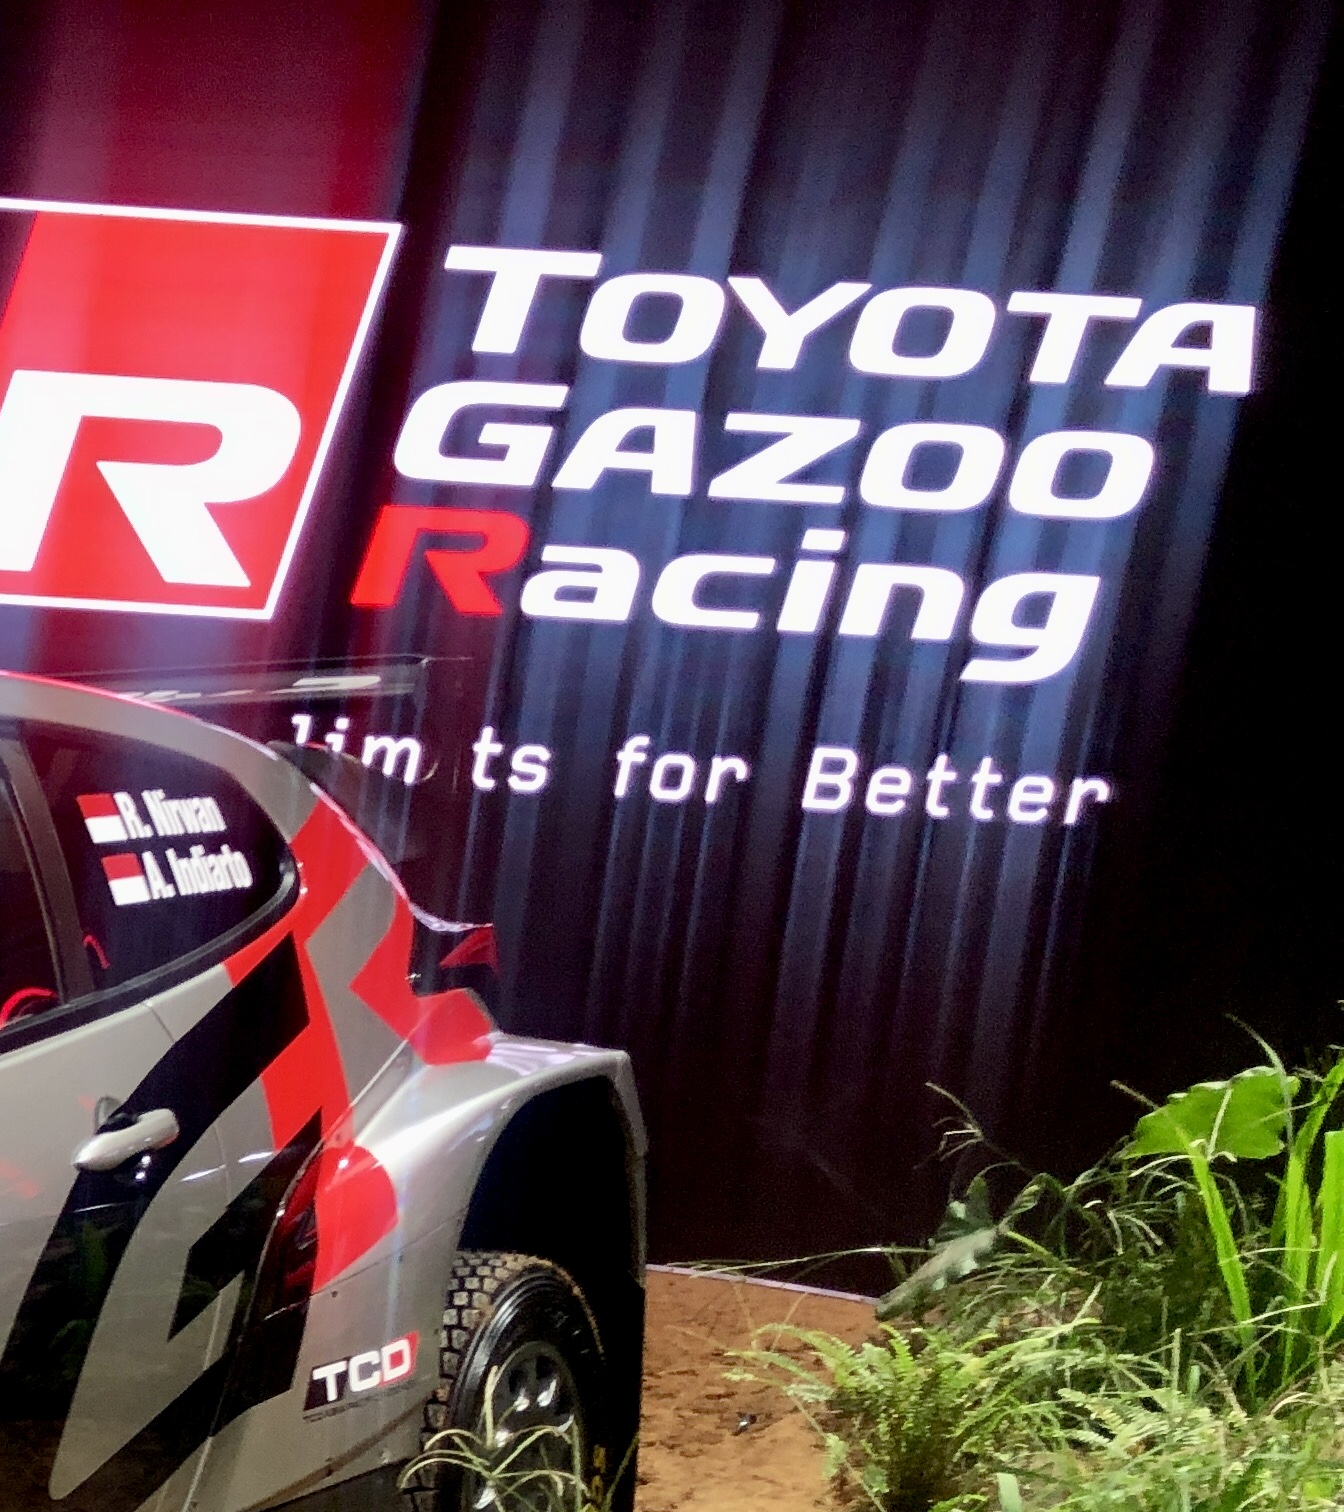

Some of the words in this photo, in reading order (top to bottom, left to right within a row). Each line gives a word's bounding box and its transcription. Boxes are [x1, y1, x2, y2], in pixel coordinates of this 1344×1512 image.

[443, 245, 1258, 394] TOYOTA
[392, 380, 1155, 518] GAZOO
[348, 504, 1107, 684] Racing
[113, 791, 153, 839] R.
[291, 714, 552, 792] limts
[612, 733, 748, 804] for
[806, 750, 1113, 827] Better
[141, 850, 176, 900] A.
[312, 1338, 412, 1402] TCD
